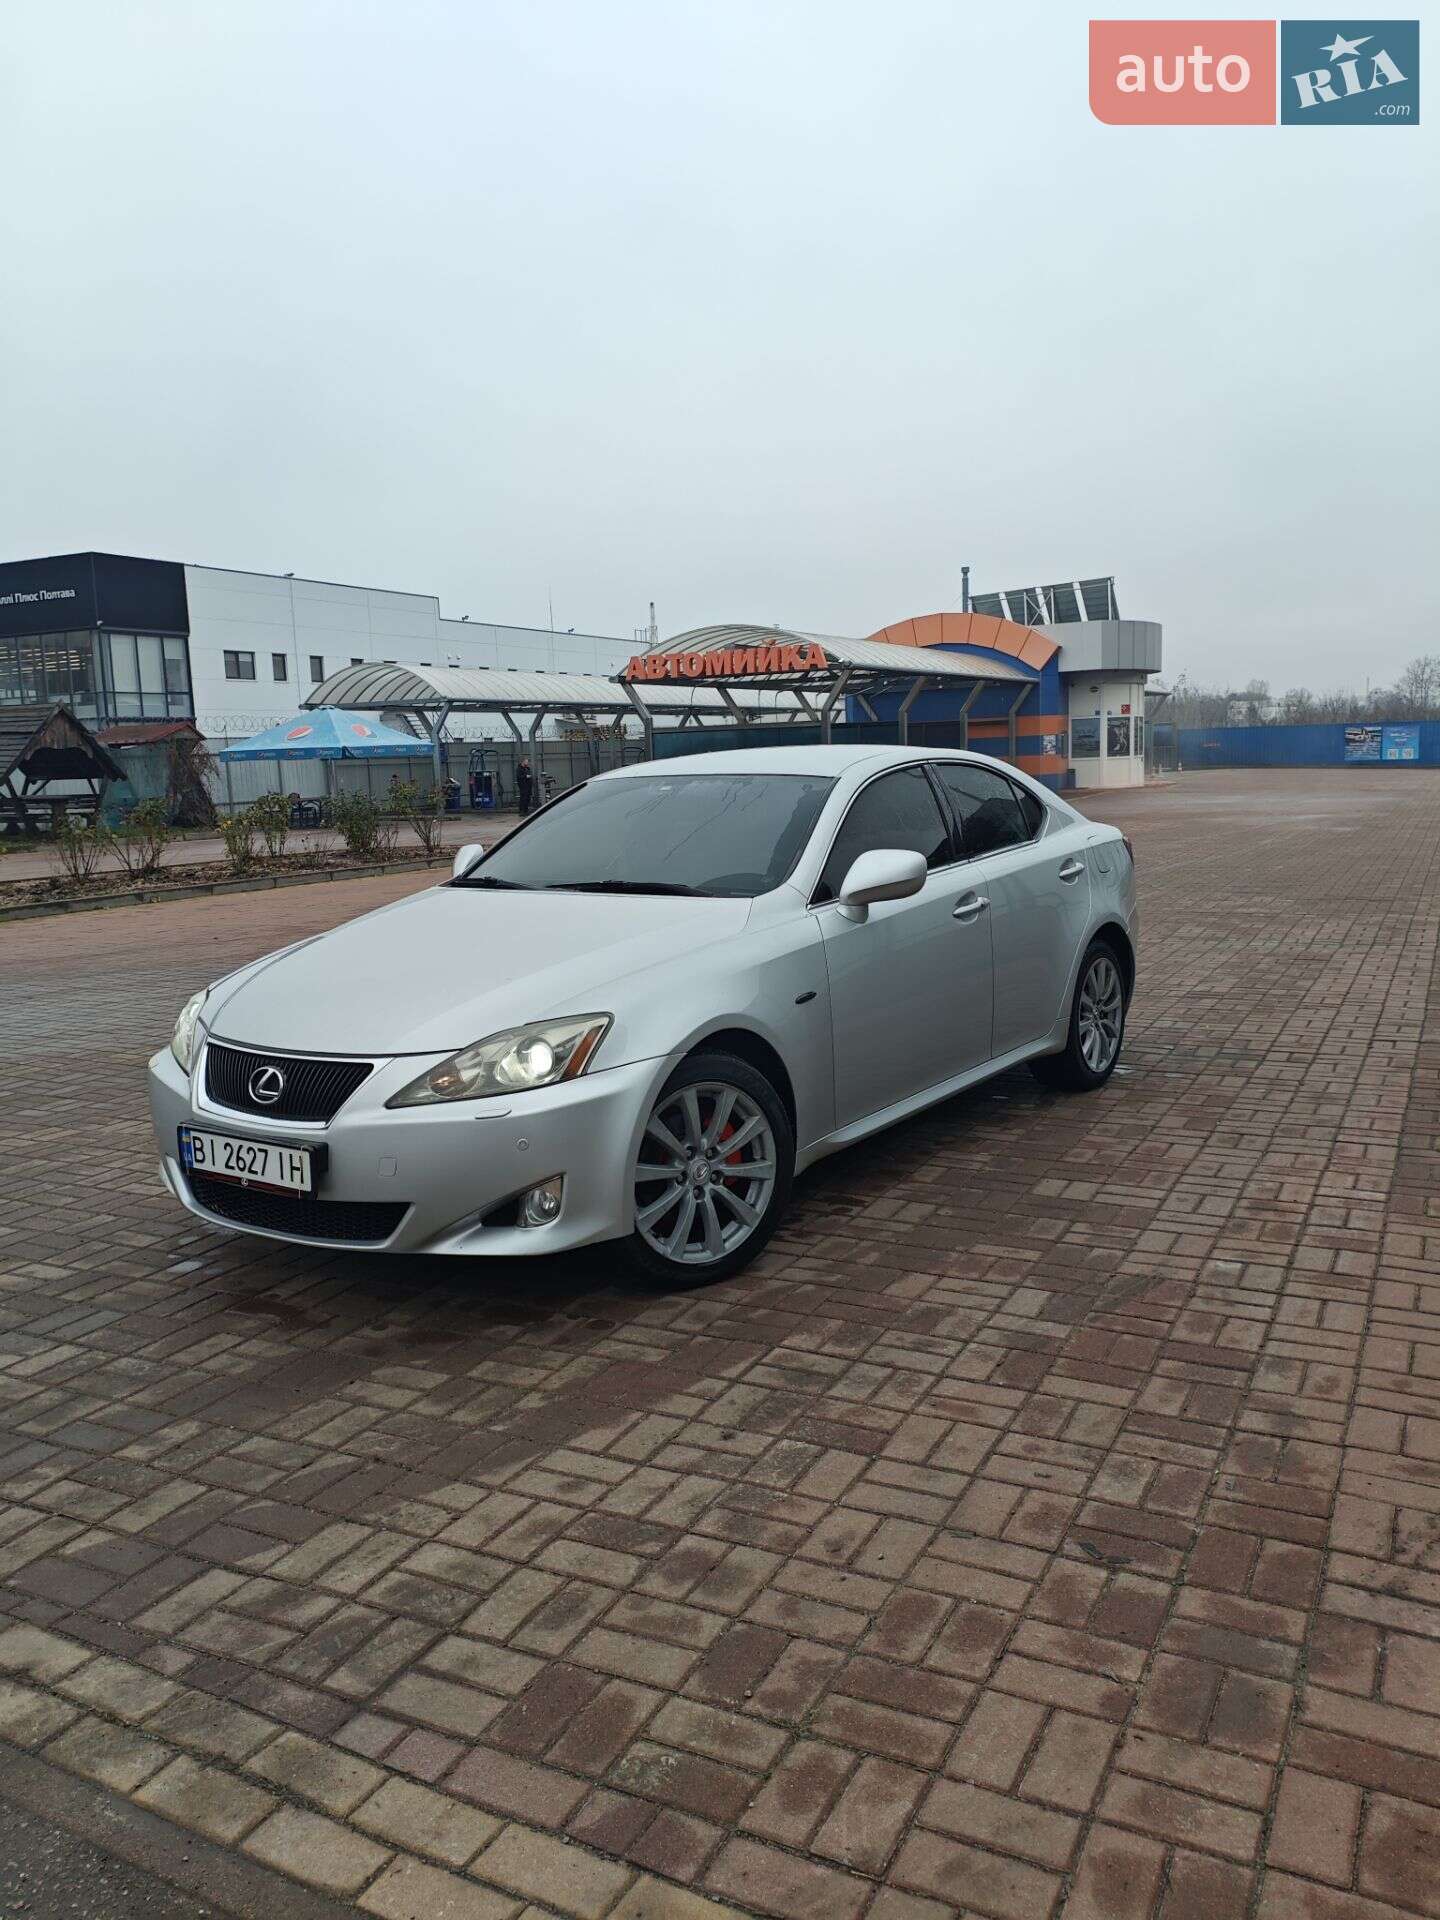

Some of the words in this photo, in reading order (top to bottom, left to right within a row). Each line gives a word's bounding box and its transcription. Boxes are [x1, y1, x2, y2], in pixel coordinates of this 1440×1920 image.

[40, 590, 75, 600] Полтава
[625, 639, 829, 682] АВТОМИЙКА
[223, 1142, 269, 1176] 2627
